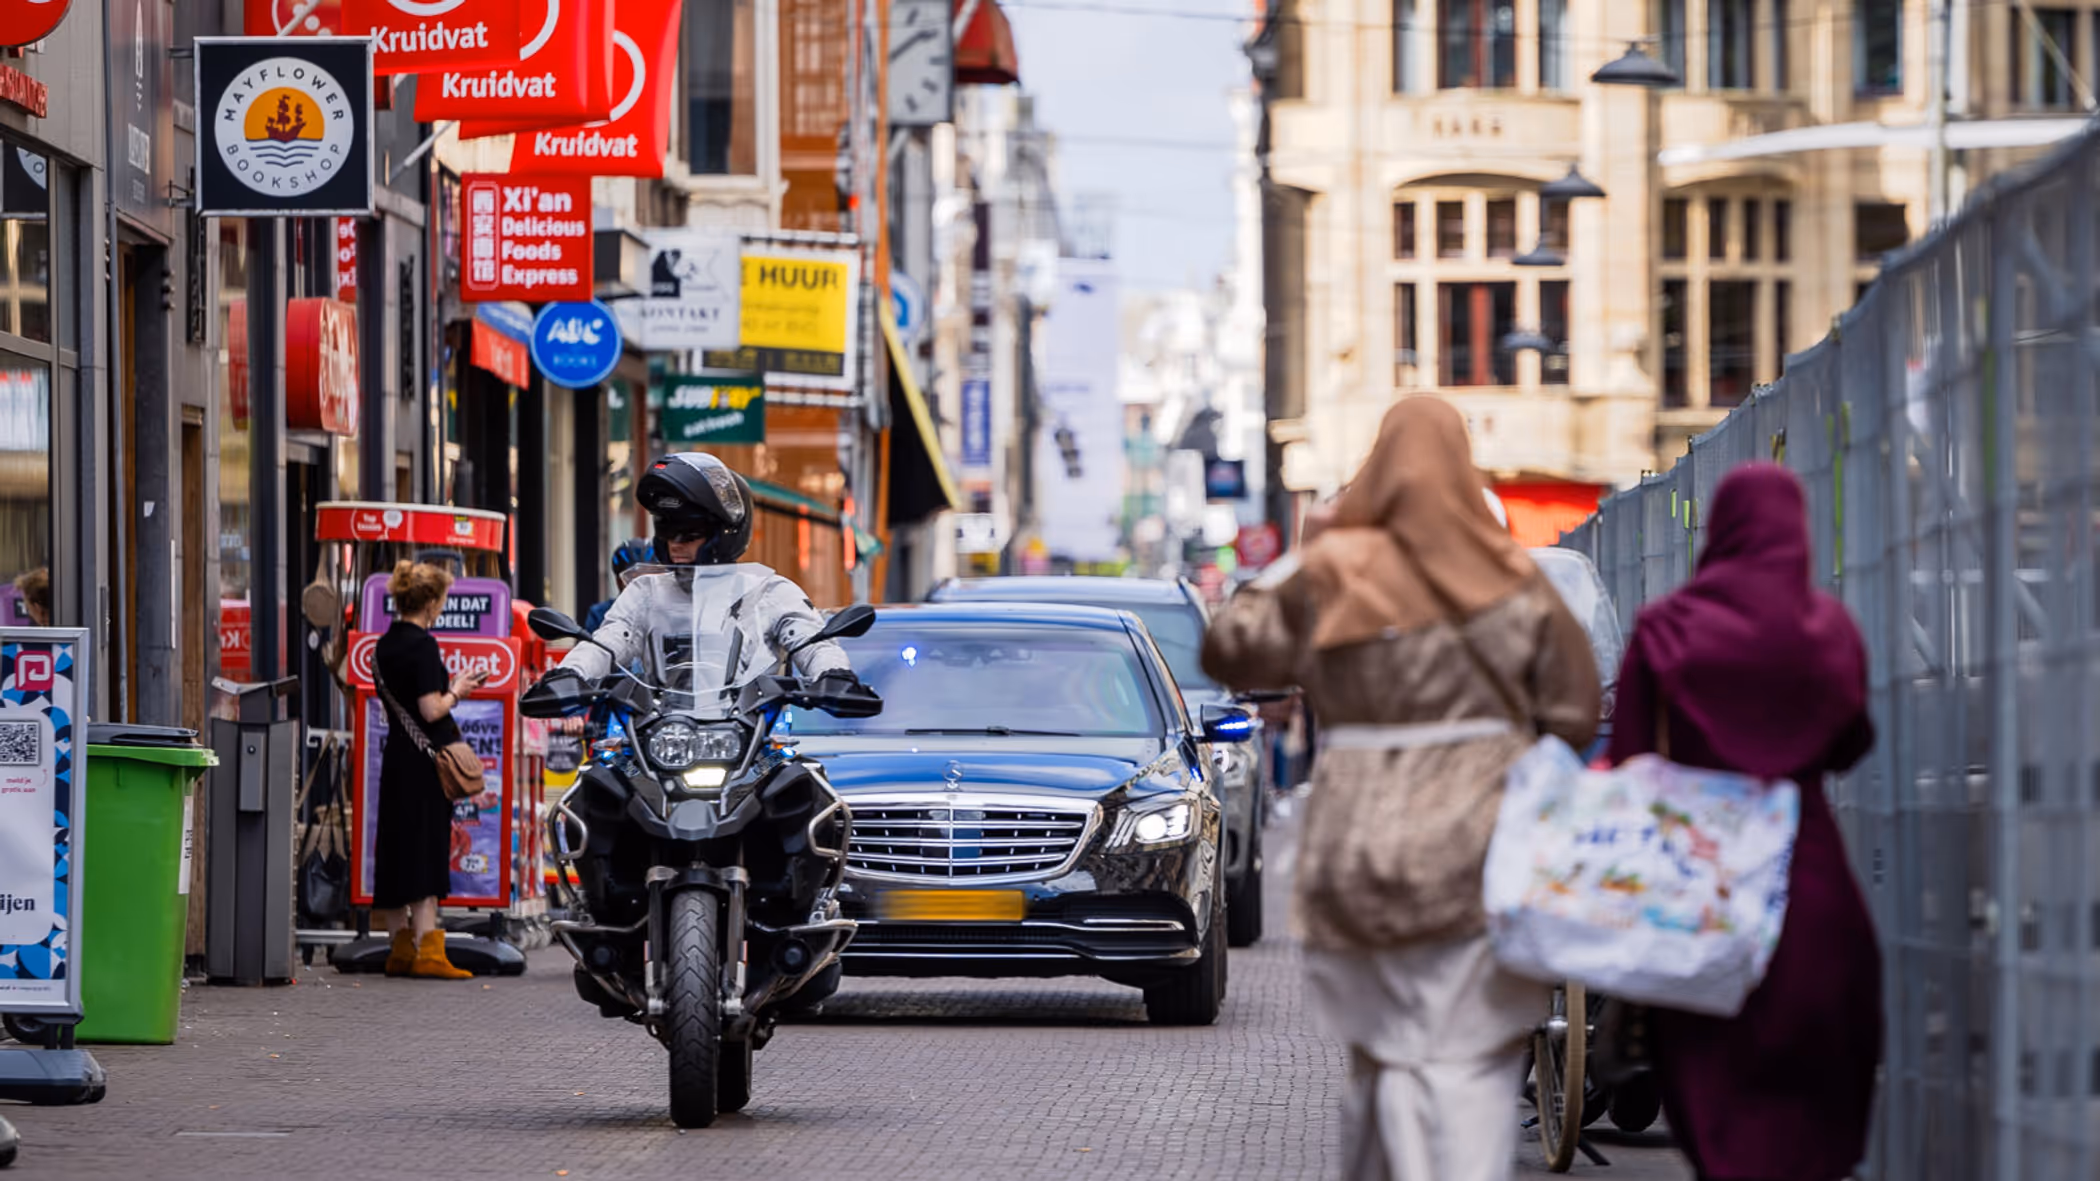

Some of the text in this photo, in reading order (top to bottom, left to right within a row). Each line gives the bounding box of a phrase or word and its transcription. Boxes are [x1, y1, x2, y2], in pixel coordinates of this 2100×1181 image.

[370, 22, 488, 52] Kruidvat
[224, 66, 344, 121] MAYFLOWER
[442, 71, 556, 99] Kruidvat
[534, 132, 638, 157] Kruidvat
[227, 144, 340, 189] BOOKSHOP
[502, 186, 572, 212] Xi'an
[502, 216, 585, 237] Delicious
[502, 240, 562, 261] Foods
[502, 264, 578, 289] Express
[759, 264, 840, 290] HUUR
[461, 597, 489, 611] DAT
